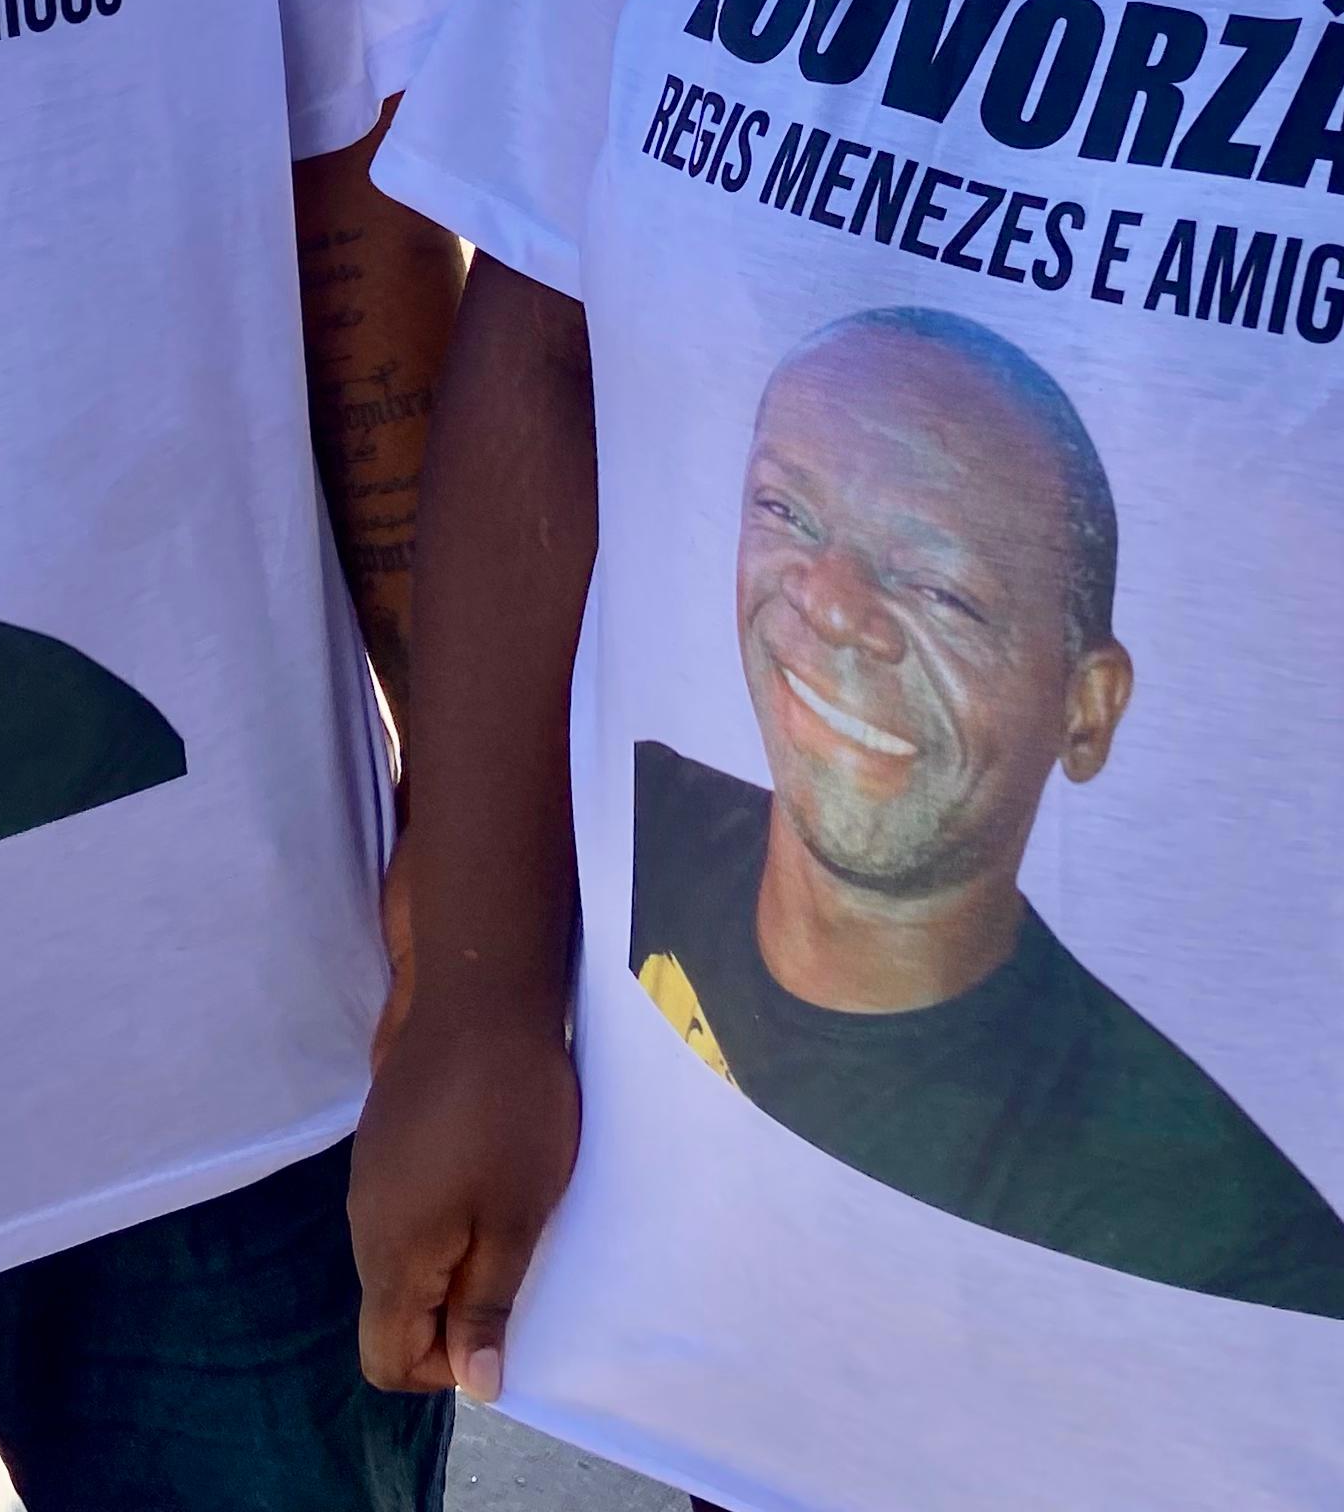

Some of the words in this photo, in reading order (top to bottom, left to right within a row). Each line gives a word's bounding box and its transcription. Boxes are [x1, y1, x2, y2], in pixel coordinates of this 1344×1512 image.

[643, 75, 770, 193] REGIS
[759, 123, 1084, 291] MENEZES
[1091, 211, 1142, 304] E
